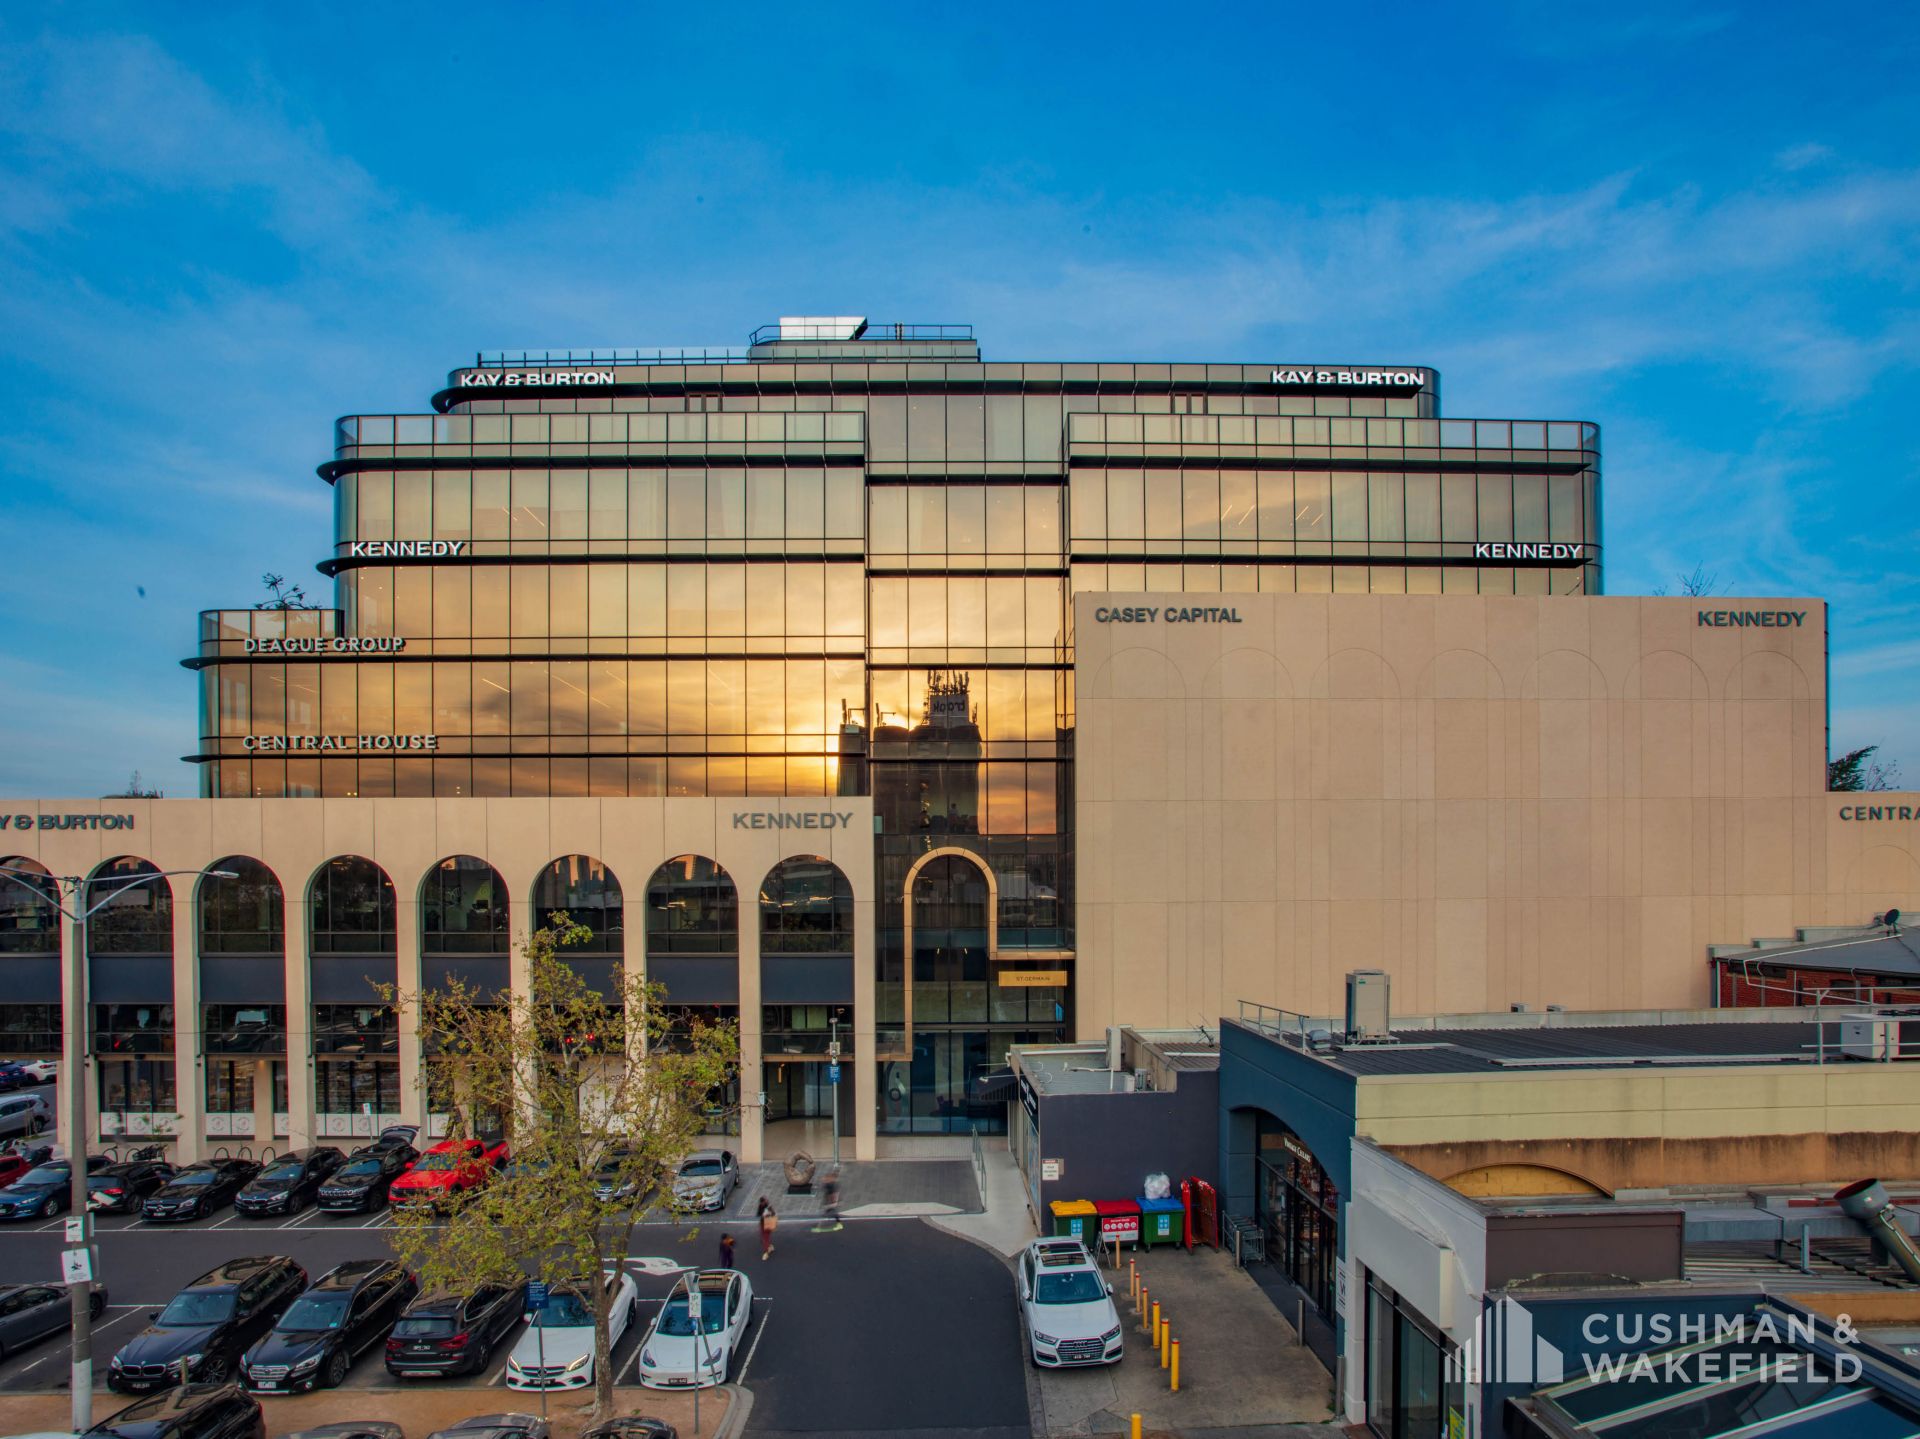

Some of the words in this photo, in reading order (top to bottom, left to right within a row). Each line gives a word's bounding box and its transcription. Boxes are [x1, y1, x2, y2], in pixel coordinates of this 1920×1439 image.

[460, 373, 501, 387] KAY
[504, 372, 521, 386] &
[525, 371, 615, 386] BURTON
[1271, 369, 1314, 384] KAY
[1316, 370, 1334, 384] &
[1337, 371, 1425, 385] BURTON
[350, 541, 464, 557] KENNEDY
[1475, 543, 1583, 560] KENNEDY
[1096, 607, 1159, 622] CASEY
[1165, 607, 1242, 622] CAPITAL
[1698, 610, 1806, 627] KENNEDY
[243, 637, 326, 652] DEAGUE
[333, 636, 405, 651] GROUP
[243, 734, 347, 750] CENTRAL
[358, 733, 439, 750] HOUSE
[14, 814, 34, 830] &
[38, 814, 134, 830] BURTON
[733, 813, 853, 829] KENNEDY
